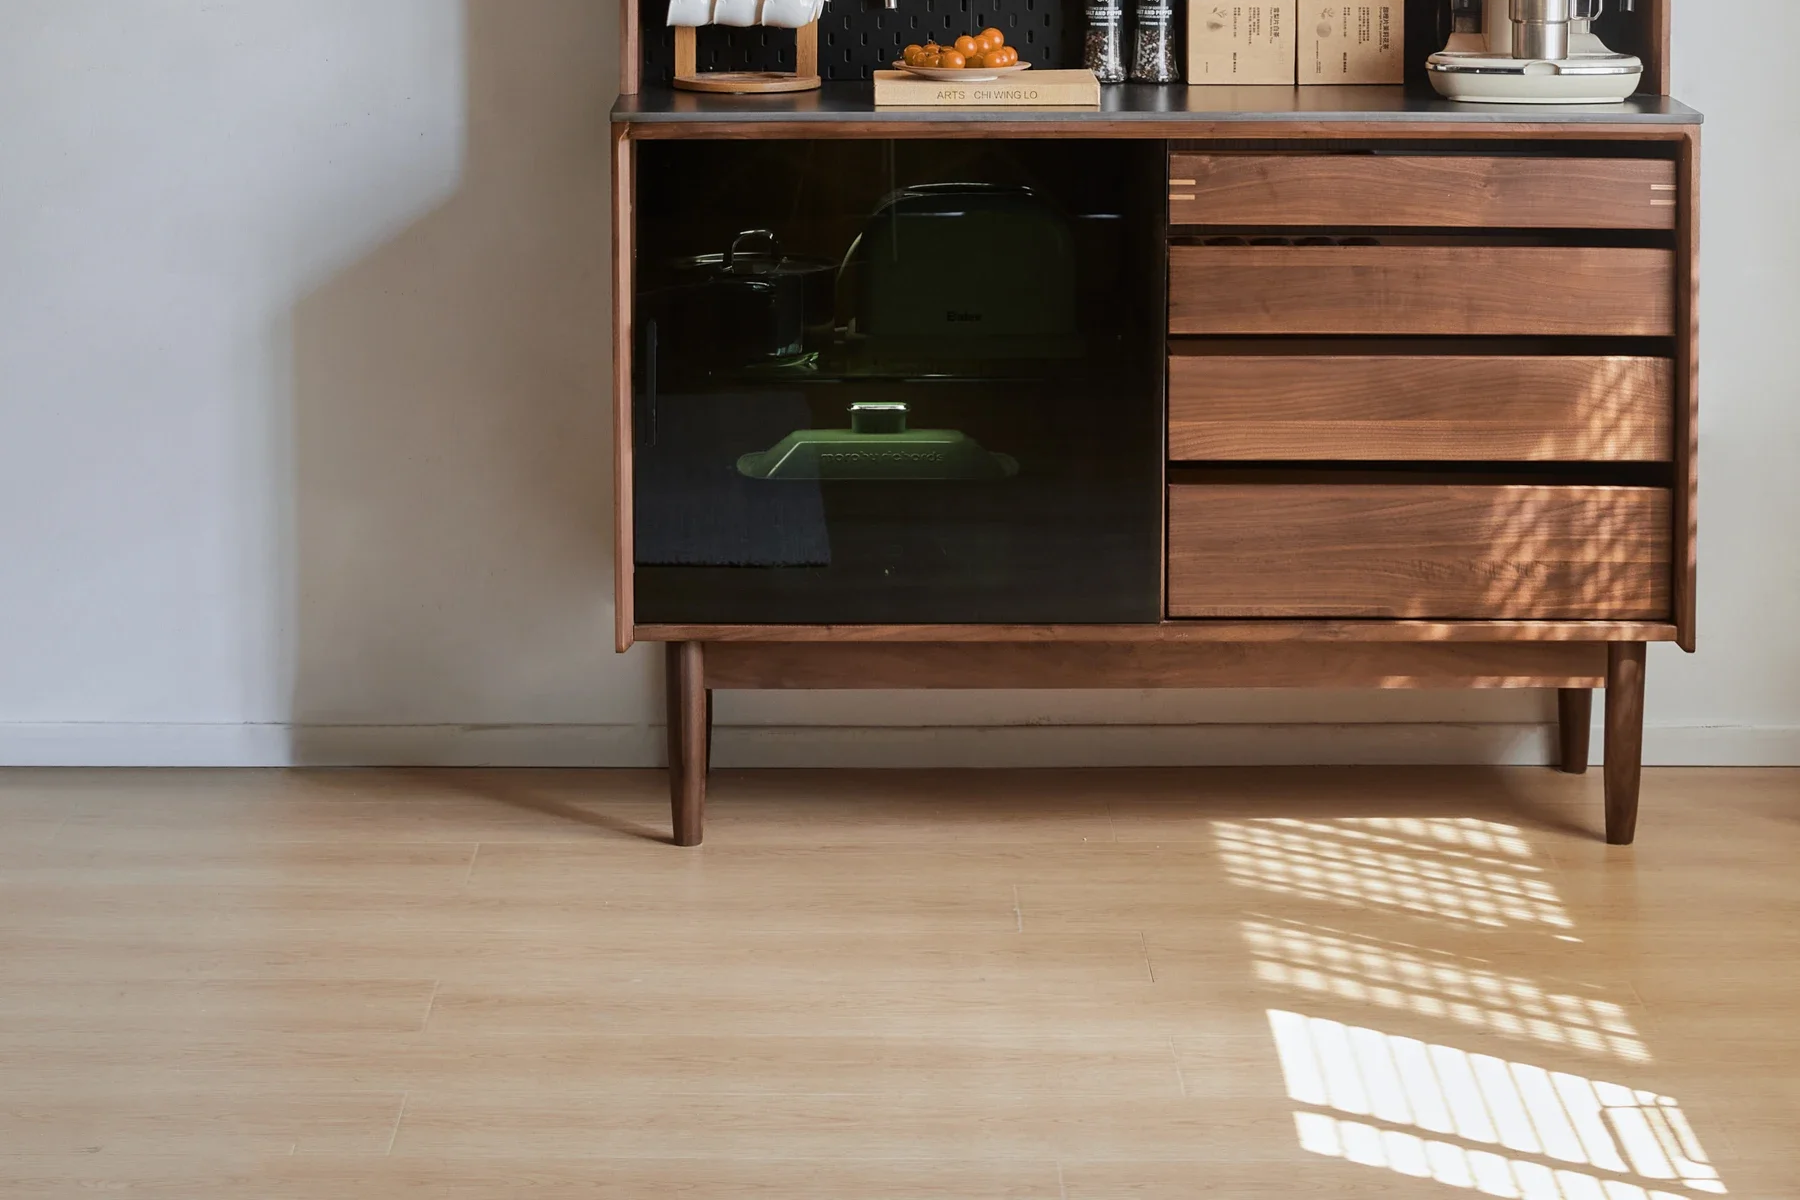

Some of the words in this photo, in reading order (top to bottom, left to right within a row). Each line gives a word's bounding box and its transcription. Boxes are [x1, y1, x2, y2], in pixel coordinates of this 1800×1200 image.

[937, 91, 965, 99] ARTS
[974, 91, 991, 99] CHI
[993, 91, 1021, 99] WING
[1024, 91, 1038, 99] LO
